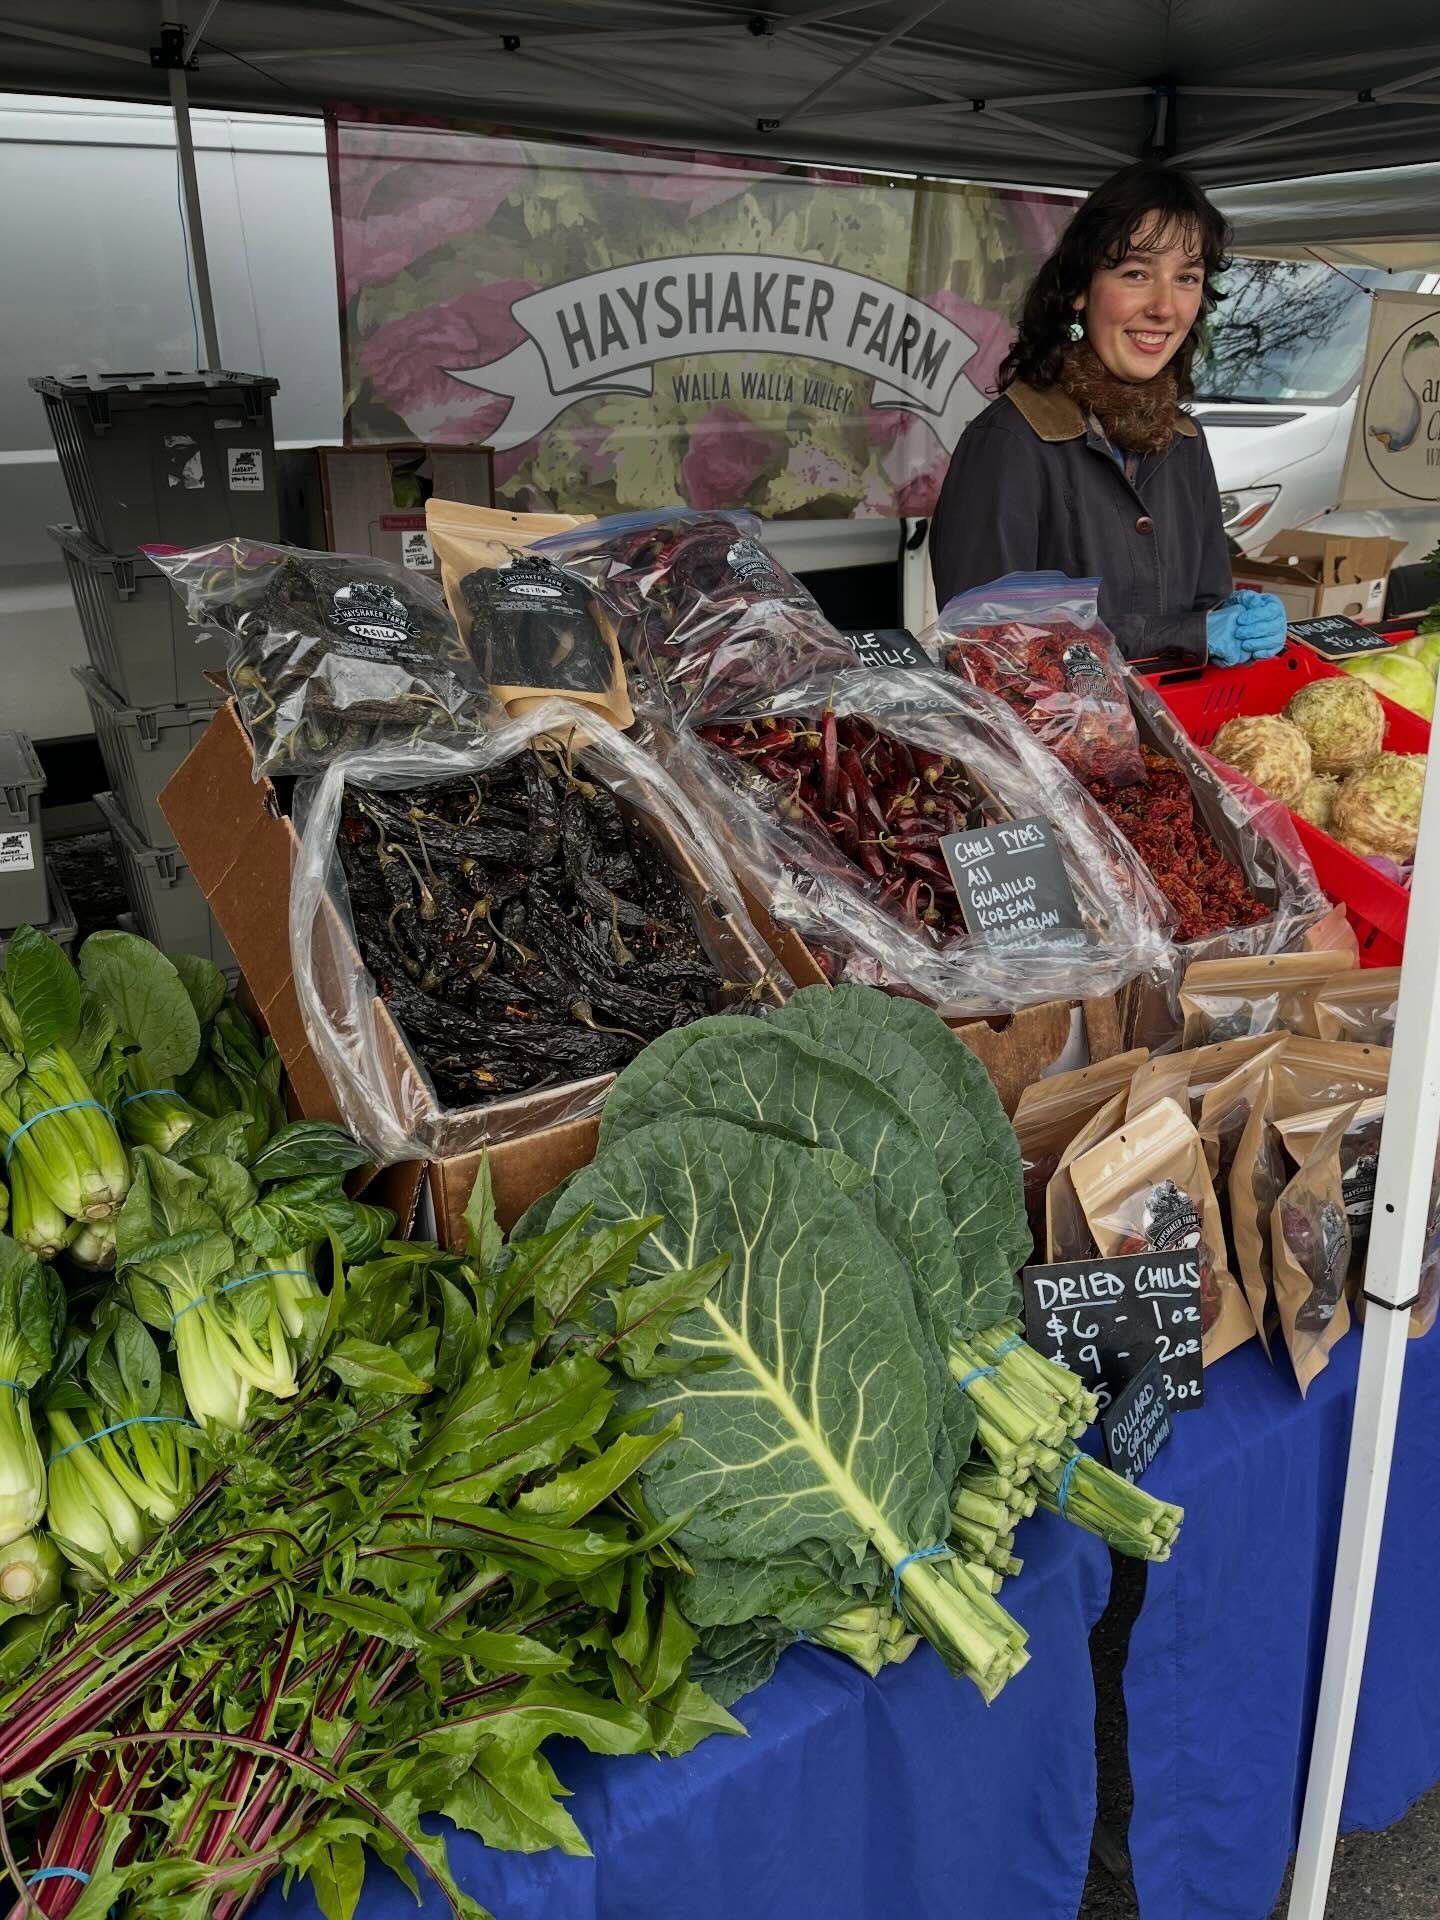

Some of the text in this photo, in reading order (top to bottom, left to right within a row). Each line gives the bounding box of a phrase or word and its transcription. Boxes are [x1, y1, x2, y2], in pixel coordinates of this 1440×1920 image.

[556, 271, 952, 390] HAYSHAKER FARM
[672, 371, 854, 414] WALLA WALLA VALLEY
[505, 574, 562, 587] HAYSHAKER FARM
[341, 609, 407, 627] HAYSHAKER FARM
[354, 626, 400, 641] PASILLA
[860, 647, 917, 667] HILIS
[955, 823, 1046, 863] CHILI TYPES
[967, 866, 993, 888] AJI
[970, 876, 1037, 909] GUAJILLO
[977, 895, 1037, 930] KOREAN
[984, 909, 1060, 946] CALABRIAN
[1156, 1218, 1183, 1248] HAYSHAKER
[1182, 1213, 1197, 1224] FARM
[1033, 1262, 1200, 1310] DRIED CHILIS
[1155, 1335, 1201, 1364] 2oz
[1111, 1384, 1154, 1455] COLLARD
[1127, 1396, 1165, 1458] GREENS
